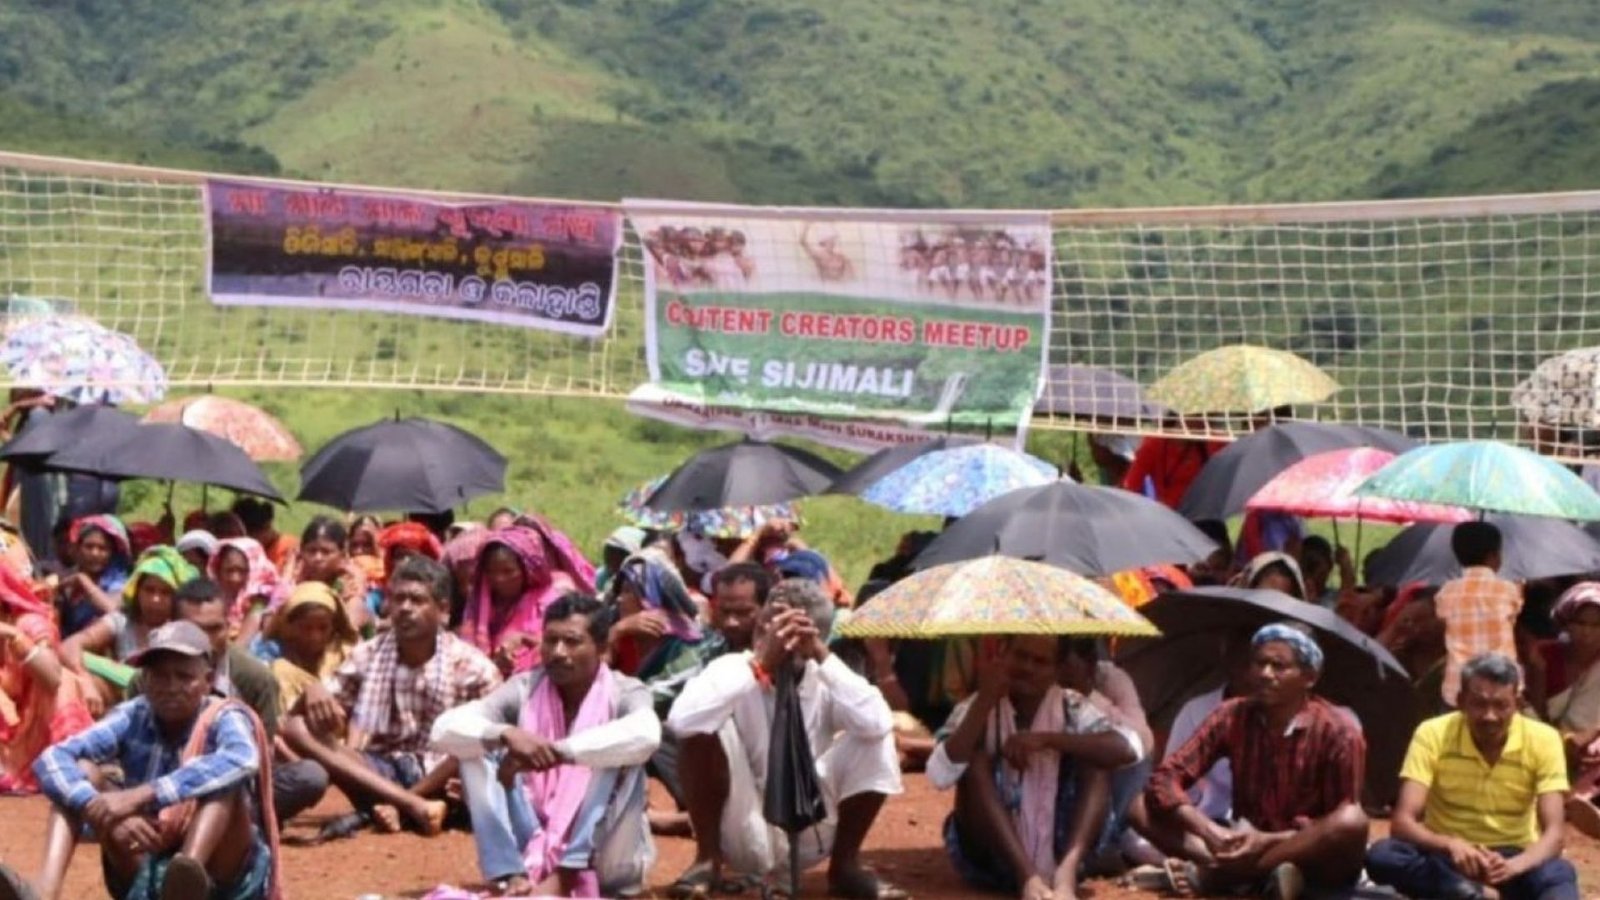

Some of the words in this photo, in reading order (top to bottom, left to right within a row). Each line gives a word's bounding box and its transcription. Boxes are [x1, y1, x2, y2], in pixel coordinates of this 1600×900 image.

[781, 311, 914, 345] CREATORS
[923, 320, 1030, 353] MEETUP
[761, 359, 914, 398] SIJIMALI
